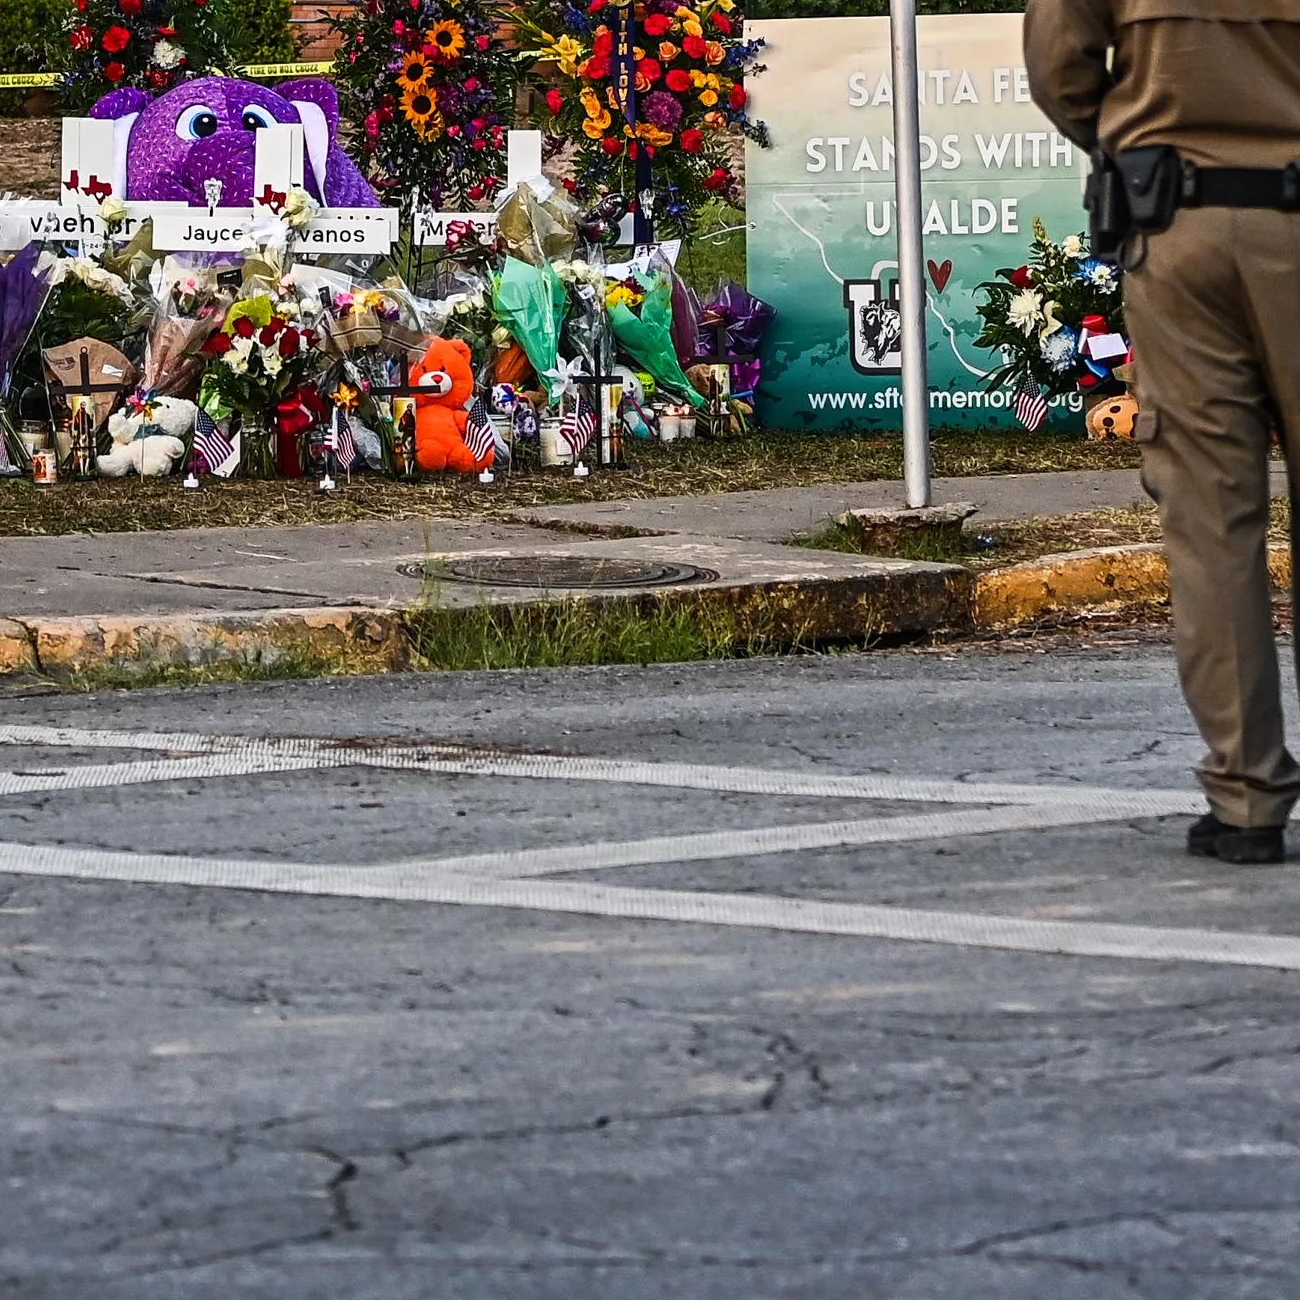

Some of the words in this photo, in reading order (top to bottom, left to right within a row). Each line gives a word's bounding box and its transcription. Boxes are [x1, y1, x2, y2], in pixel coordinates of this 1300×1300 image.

[618, 8, 629, 55] WITH
[992, 67, 1031, 104] FE
[974, 132, 1073, 170] WITH
[183, 224, 244, 245] Jayce
[297, 229, 365, 243] vanos
[866, 198, 1019, 237] UALDE
